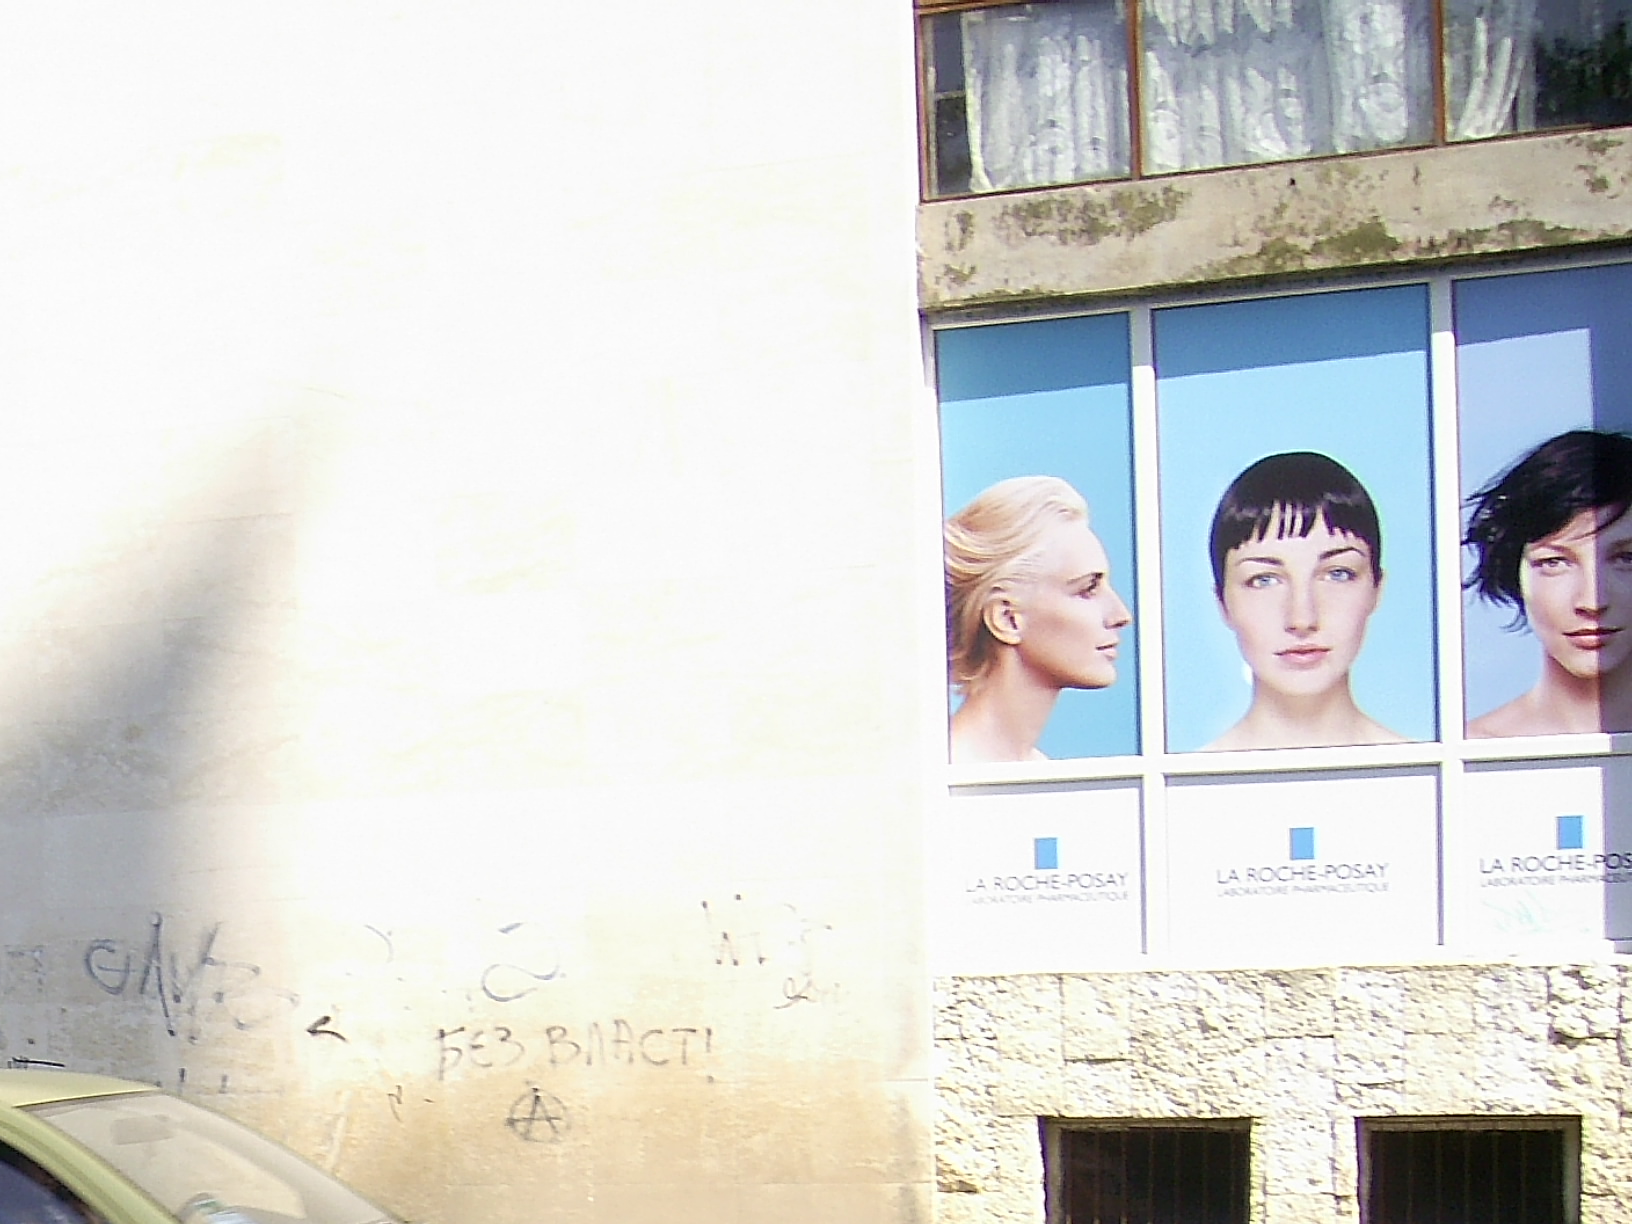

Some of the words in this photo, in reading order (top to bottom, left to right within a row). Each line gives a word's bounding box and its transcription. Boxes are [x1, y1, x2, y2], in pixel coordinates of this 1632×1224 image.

[1217, 869, 1239, 884] LA
[1247, 863, 1389, 882] ROCHE-POSAY
[1479, 857, 1504, 874] LA
[993, 872, 1128, 891] ROCHE-POSAY
[436, 1026, 525, 1080] БЕЗ
